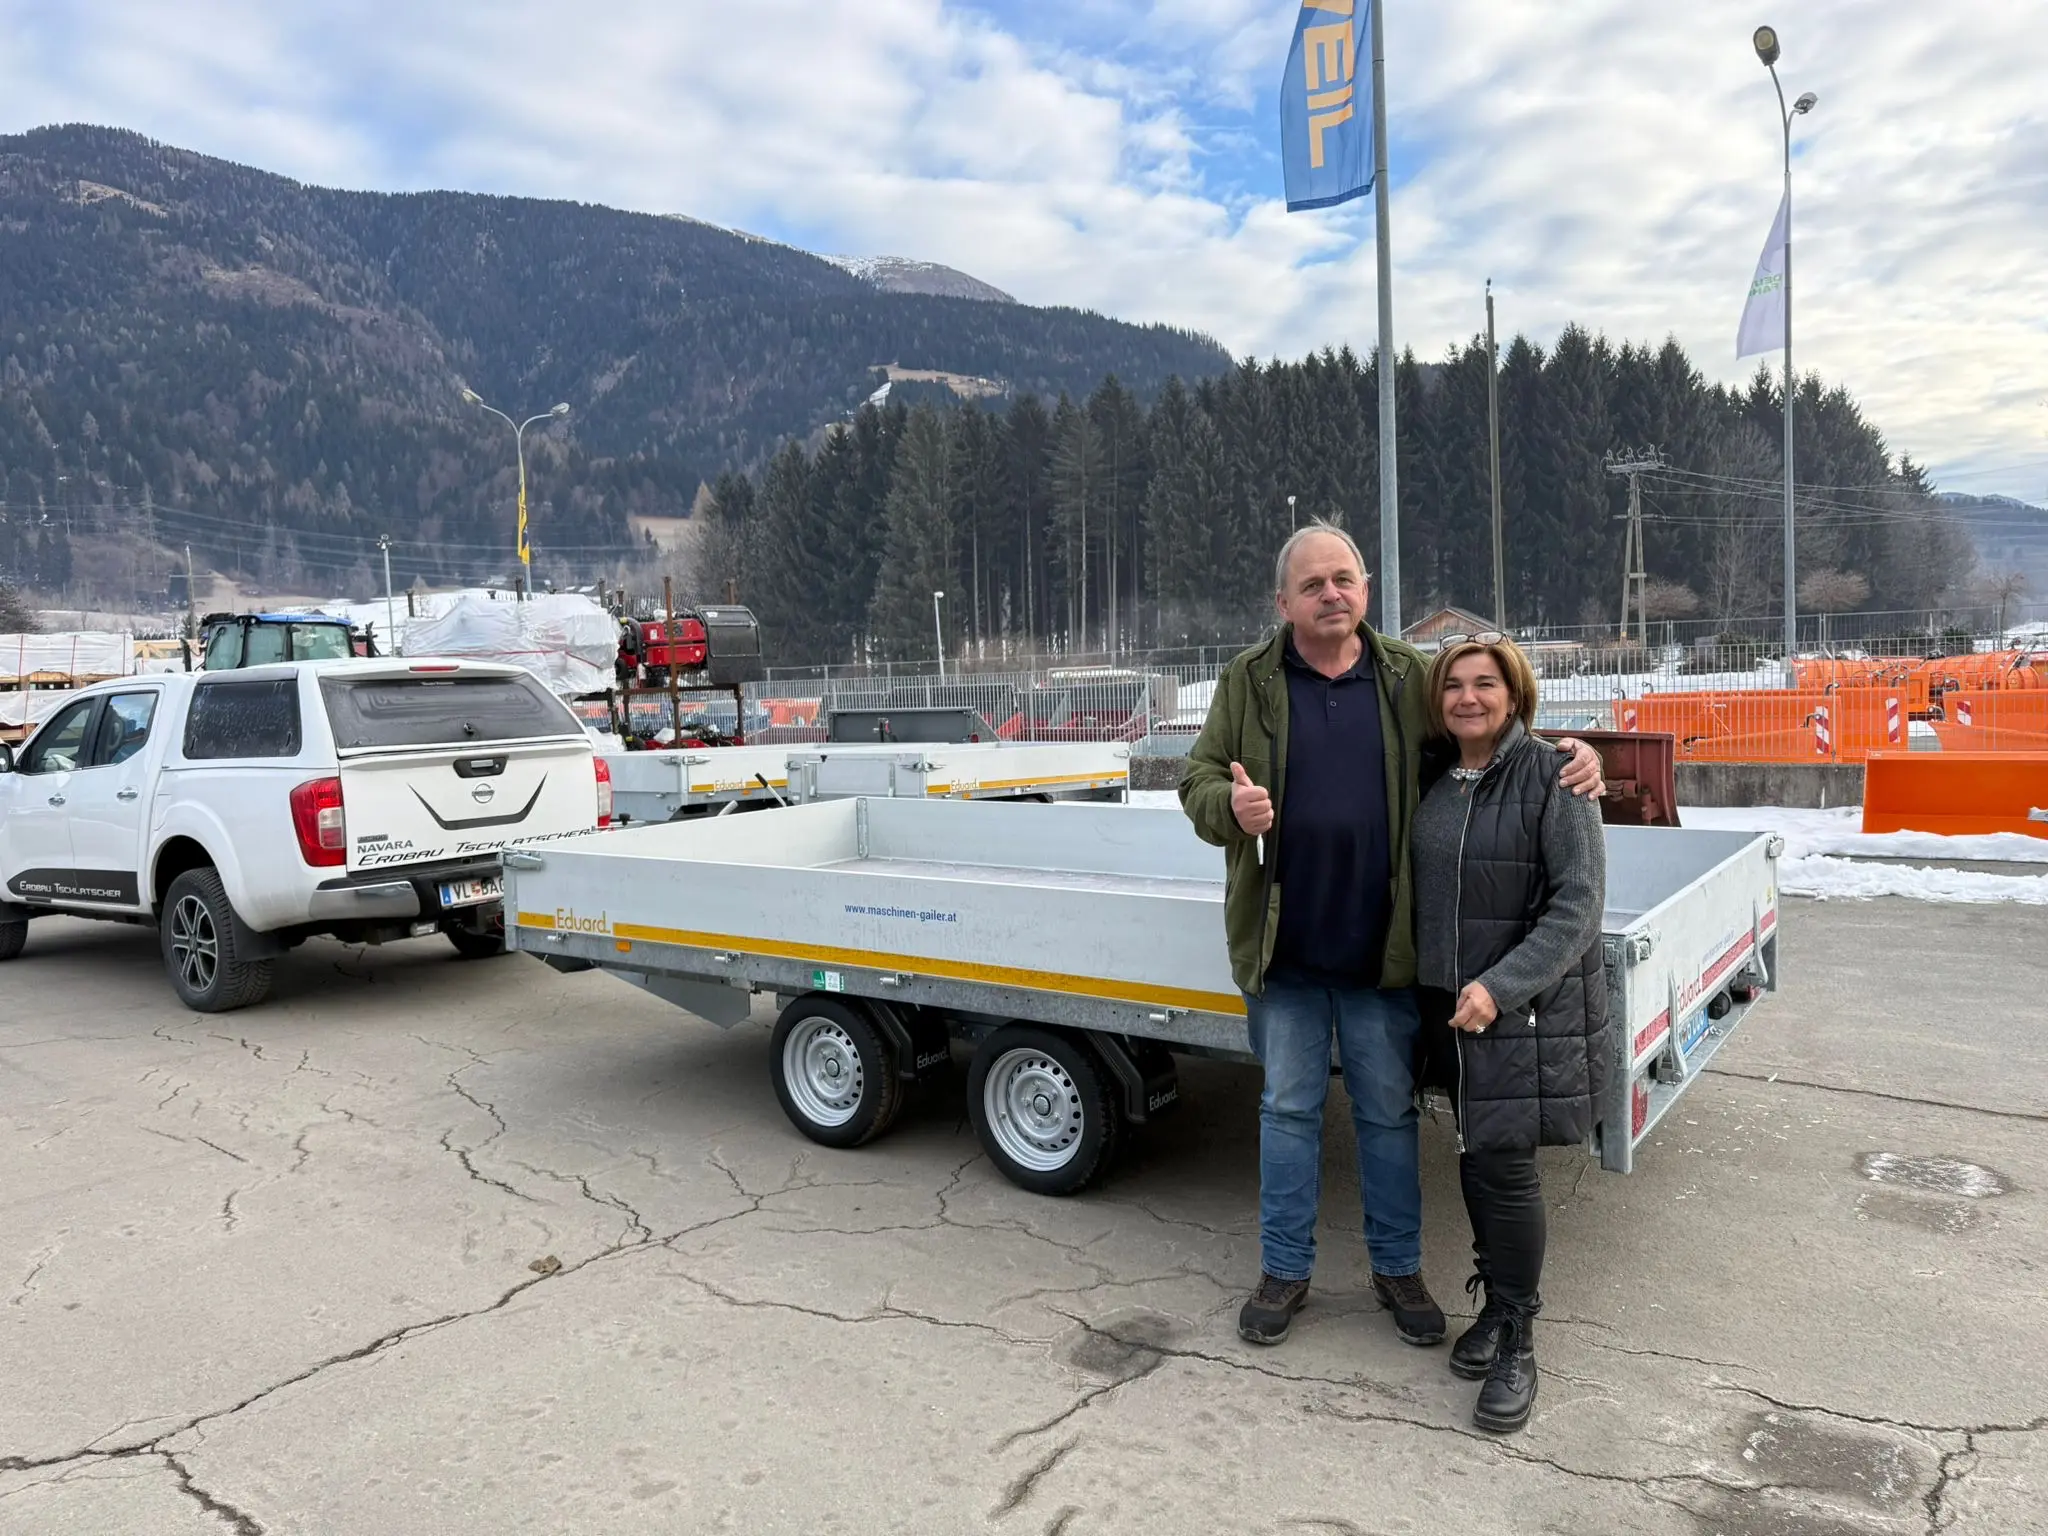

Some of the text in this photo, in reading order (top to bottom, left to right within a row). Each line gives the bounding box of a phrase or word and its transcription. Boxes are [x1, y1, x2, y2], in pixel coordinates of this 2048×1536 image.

[951, 777, 979, 790] Eduard
[357, 840, 413, 854] NAVARA
[453, 881, 471, 899] VL
[556, 906, 611, 933] Eduard
[844, 904, 957, 922] www.maschinen-gailer.at
[917, 1046, 949, 1069] Eduard
[1149, 1082, 1178, 1111] Eduard
